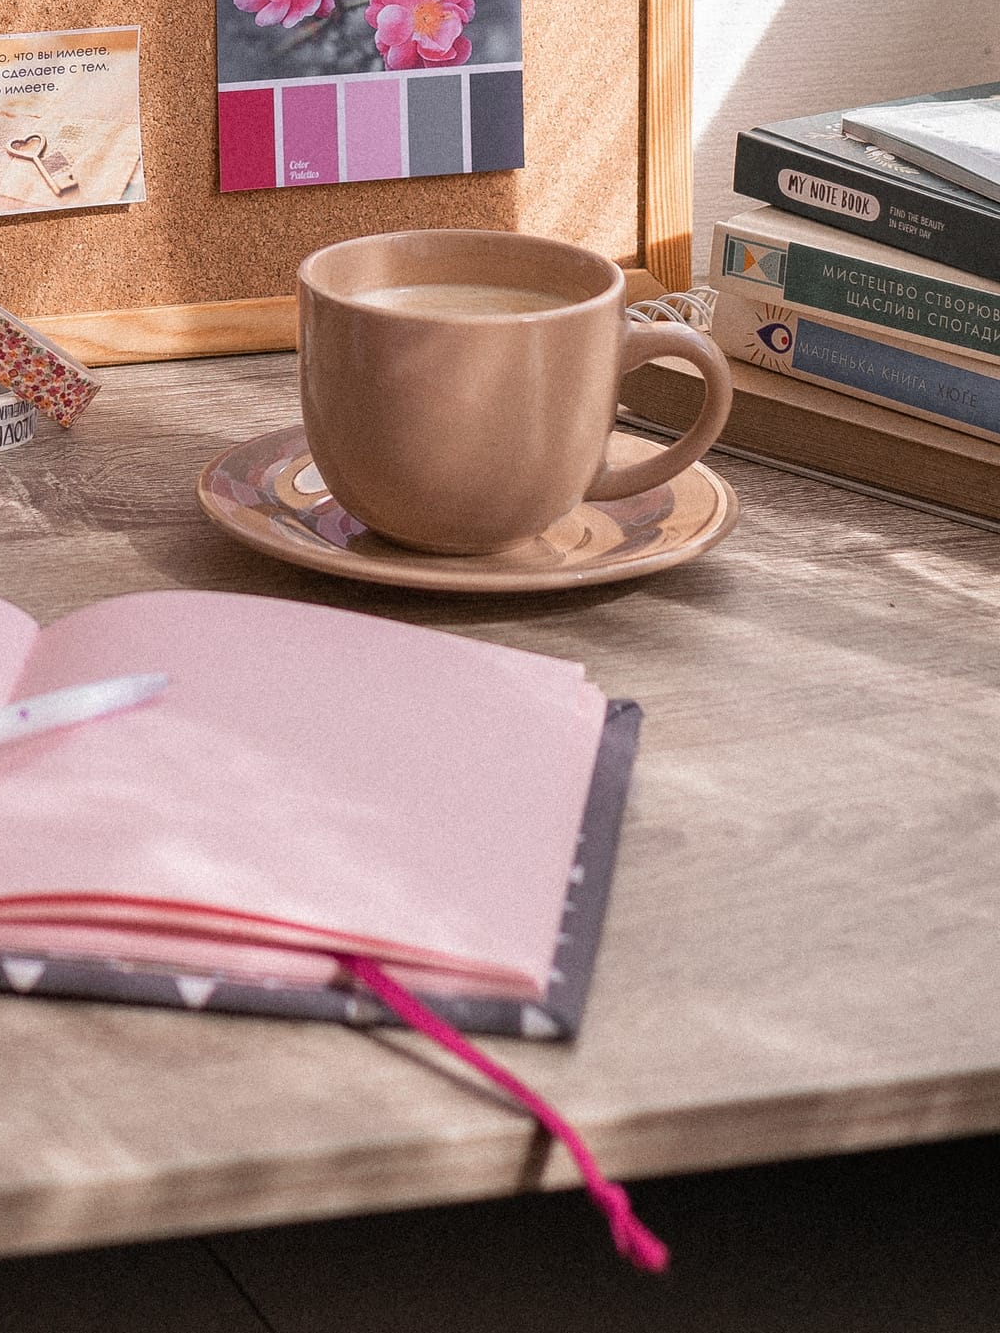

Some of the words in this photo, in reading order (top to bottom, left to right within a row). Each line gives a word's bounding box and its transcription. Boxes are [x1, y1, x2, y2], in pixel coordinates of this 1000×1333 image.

[14, 50, 34, 62] что
[37, 49, 53, 60] вы
[56, 45, 111, 58] имеете,
[1, 64, 66, 79] сделаете
[69, 63, 78, 74] с
[81, 61, 110, 73] тем,
[5, 81, 60, 94] имеете.
[788, 173, 808, 195] MY
[809, 180, 839, 206] NOTE
[841, 190, 871, 215] BOOK
[888, 218, 897, 228] IN
[898, 220, 919, 235] EVERY
[918, 227, 933, 240] DAY
[889, 205, 906, 219] FIND
[907, 210, 920, 224] THE
[920, 215, 946, 232] BEAUTY
[822, 264, 918, 300] МИСТЕЦТВО
[846, 290, 920, 321] ЩАСЛИВІ
[798, 341, 875, 373] МАЛЕНЬКА
[880, 364, 927, 392] КНИГА
